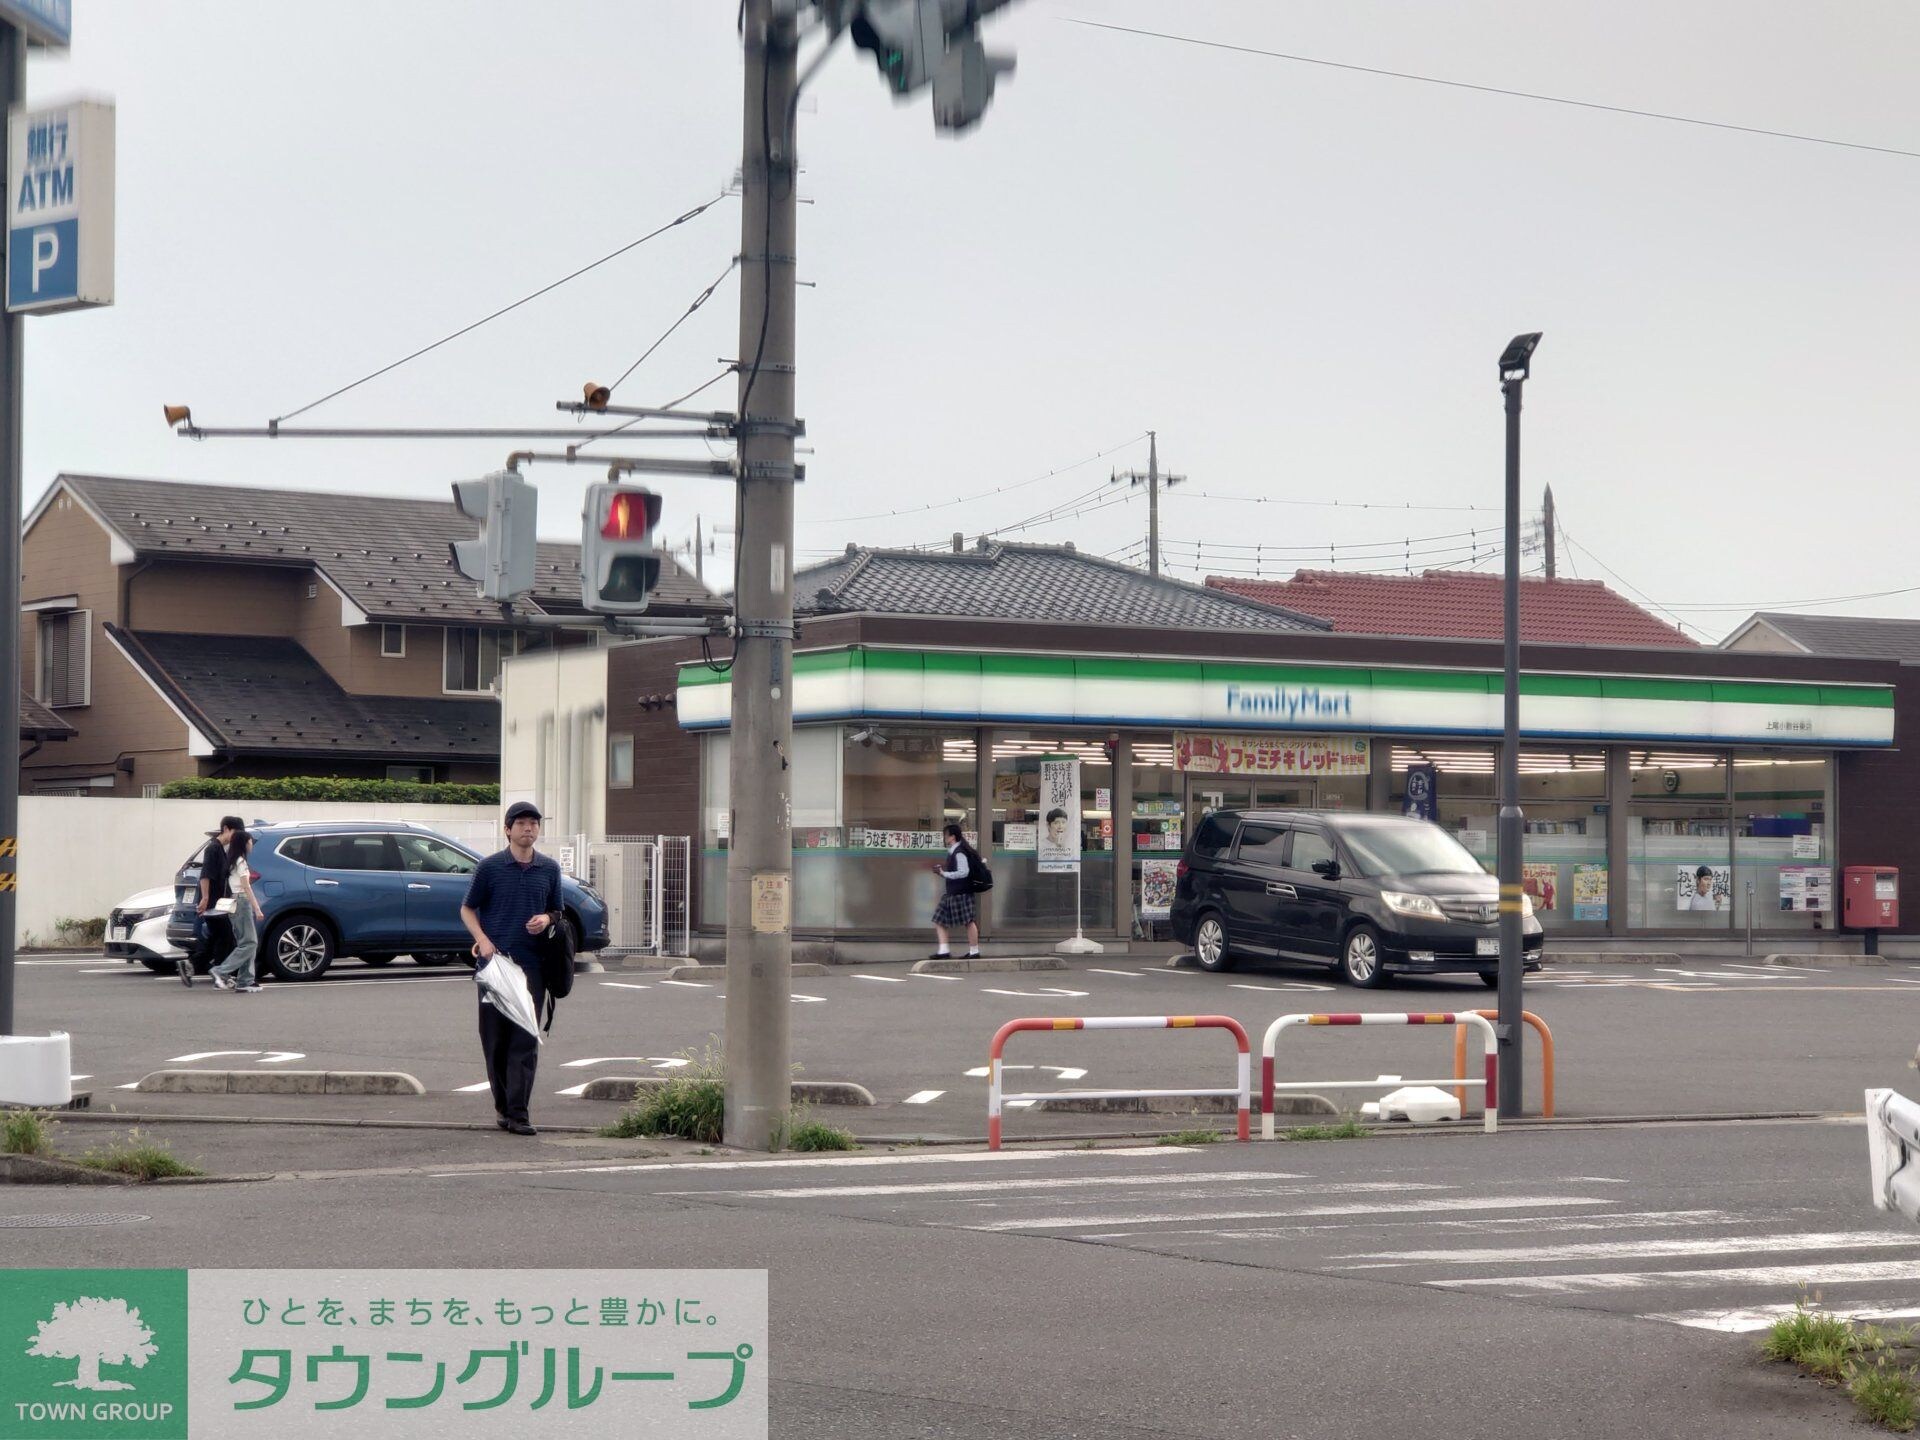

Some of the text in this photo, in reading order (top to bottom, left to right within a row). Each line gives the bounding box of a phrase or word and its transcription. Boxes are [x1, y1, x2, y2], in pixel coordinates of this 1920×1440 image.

[17, 167, 73, 213] ATM
[32, 232, 58, 293] P
[1226, 684, 1352, 722] FamilyMart
[865, 831, 933, 848] うなぎご予約承り中
